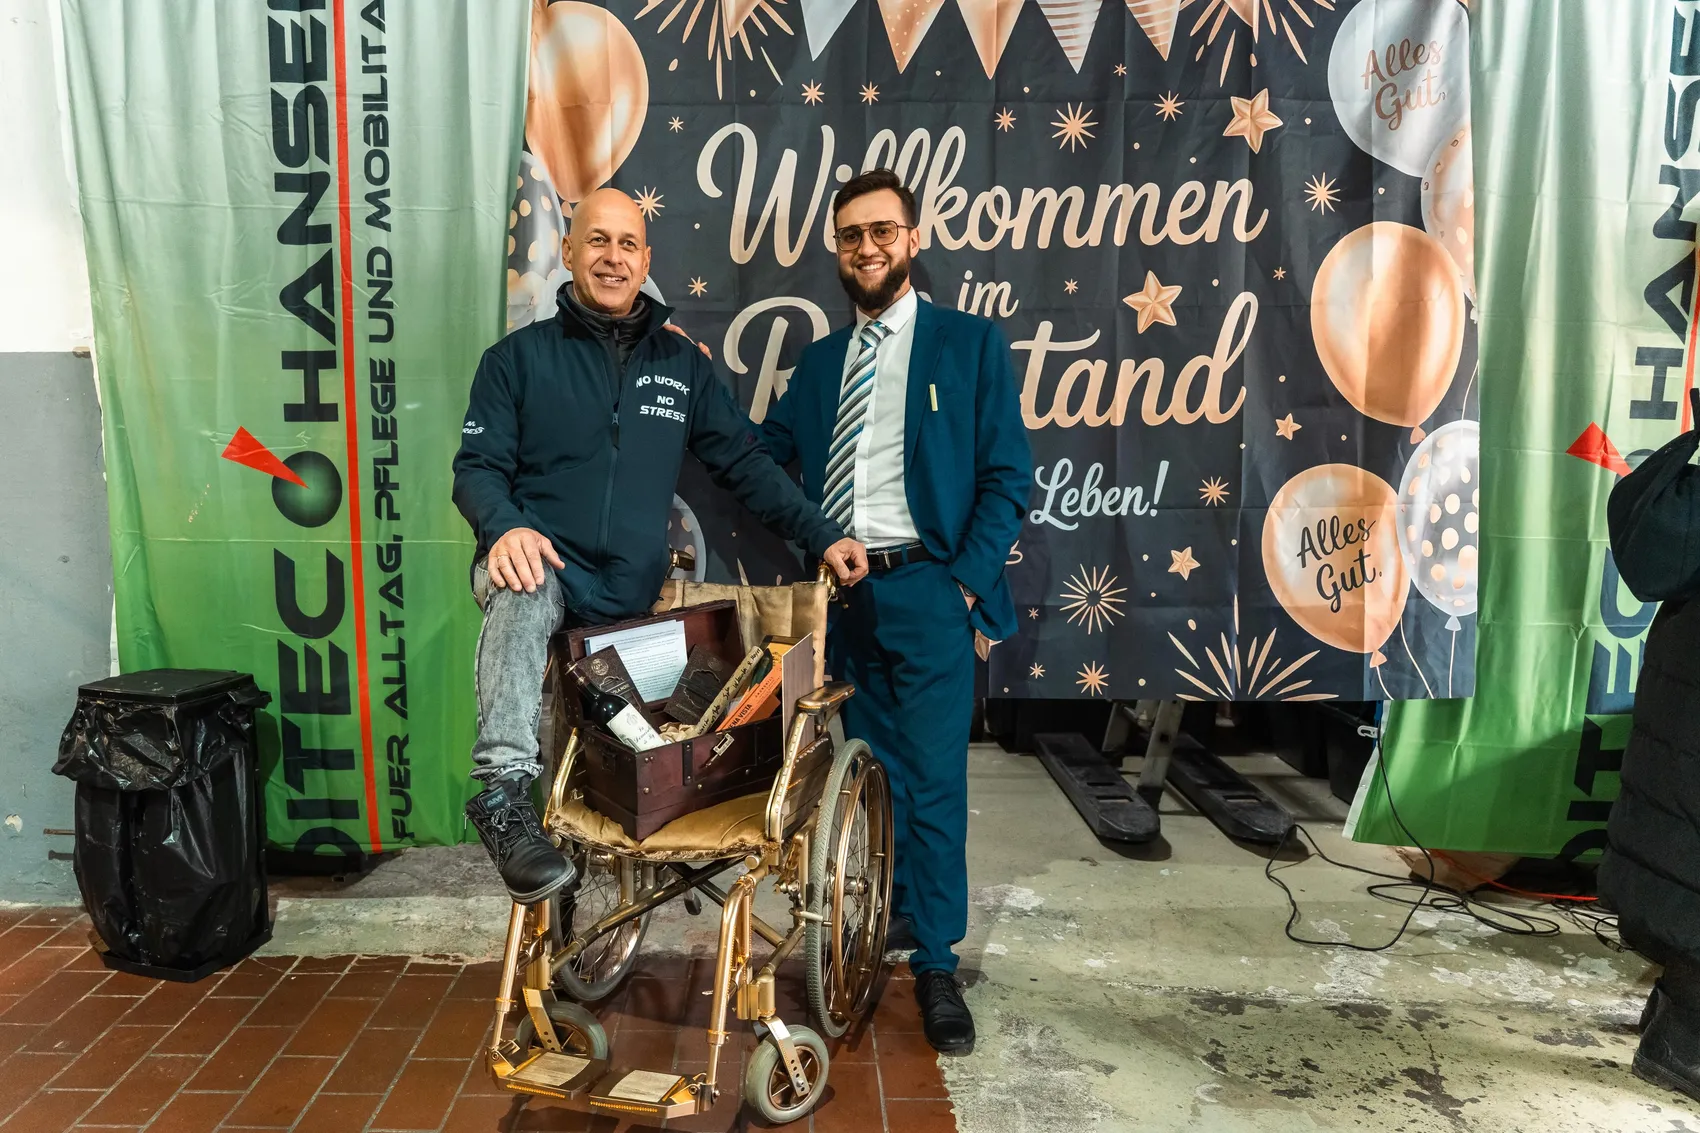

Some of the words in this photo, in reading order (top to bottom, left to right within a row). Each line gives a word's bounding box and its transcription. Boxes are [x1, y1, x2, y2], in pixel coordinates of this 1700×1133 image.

[1360, 38, 1443, 90] Alles
[267, 0, 339, 422] HANSE
[366, 246, 395, 343] UND
[957, 270, 1019, 317] im
[635, 375, 651, 388] NO
[653, 374, 690, 396] WORK
[723, 291, 1259, 430] Rtand
[640, 405, 687, 423] STRESS
[656, 395, 675, 406] NO
[370, 357, 401, 521] PFLEGE
[1029, 457, 1170, 531] Leben!
[1296, 515, 1376, 568] Alles
[376, 534, 408, 720] ALLTAG,
[738, 703, 753, 718] VISTA
[386, 734, 415, 841] FUER
